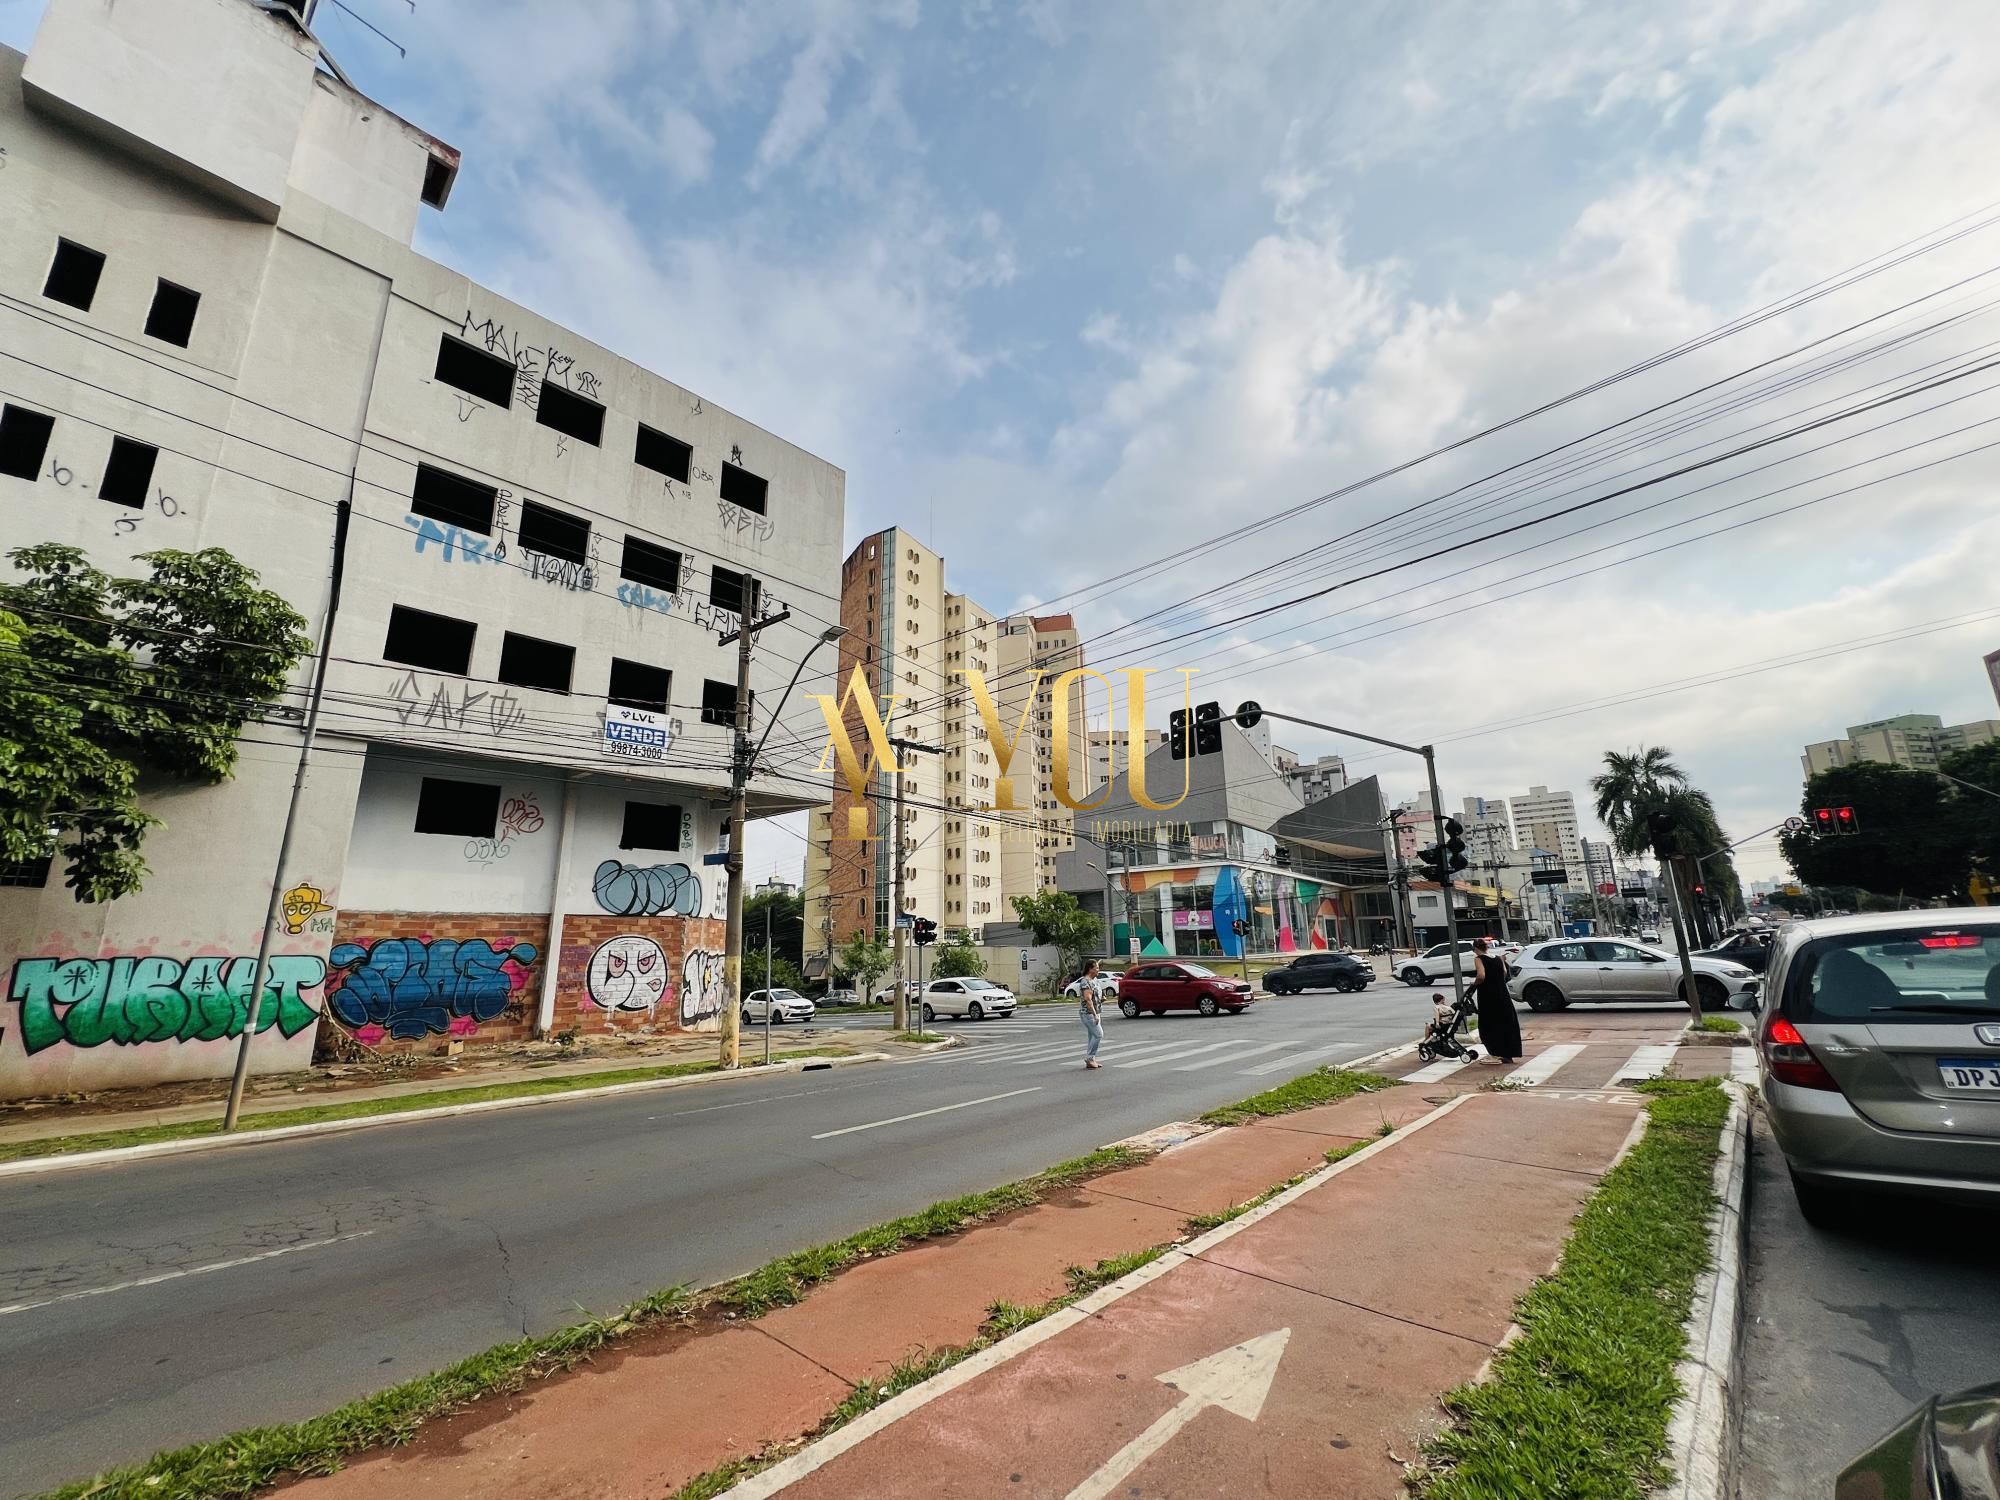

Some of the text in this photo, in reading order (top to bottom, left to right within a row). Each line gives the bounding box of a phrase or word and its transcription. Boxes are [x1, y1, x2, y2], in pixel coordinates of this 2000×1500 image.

[632, 712, 655, 724] LVL
[609, 723, 664, 745] VENDE
[611, 741, 662, 760] 99874-3000
